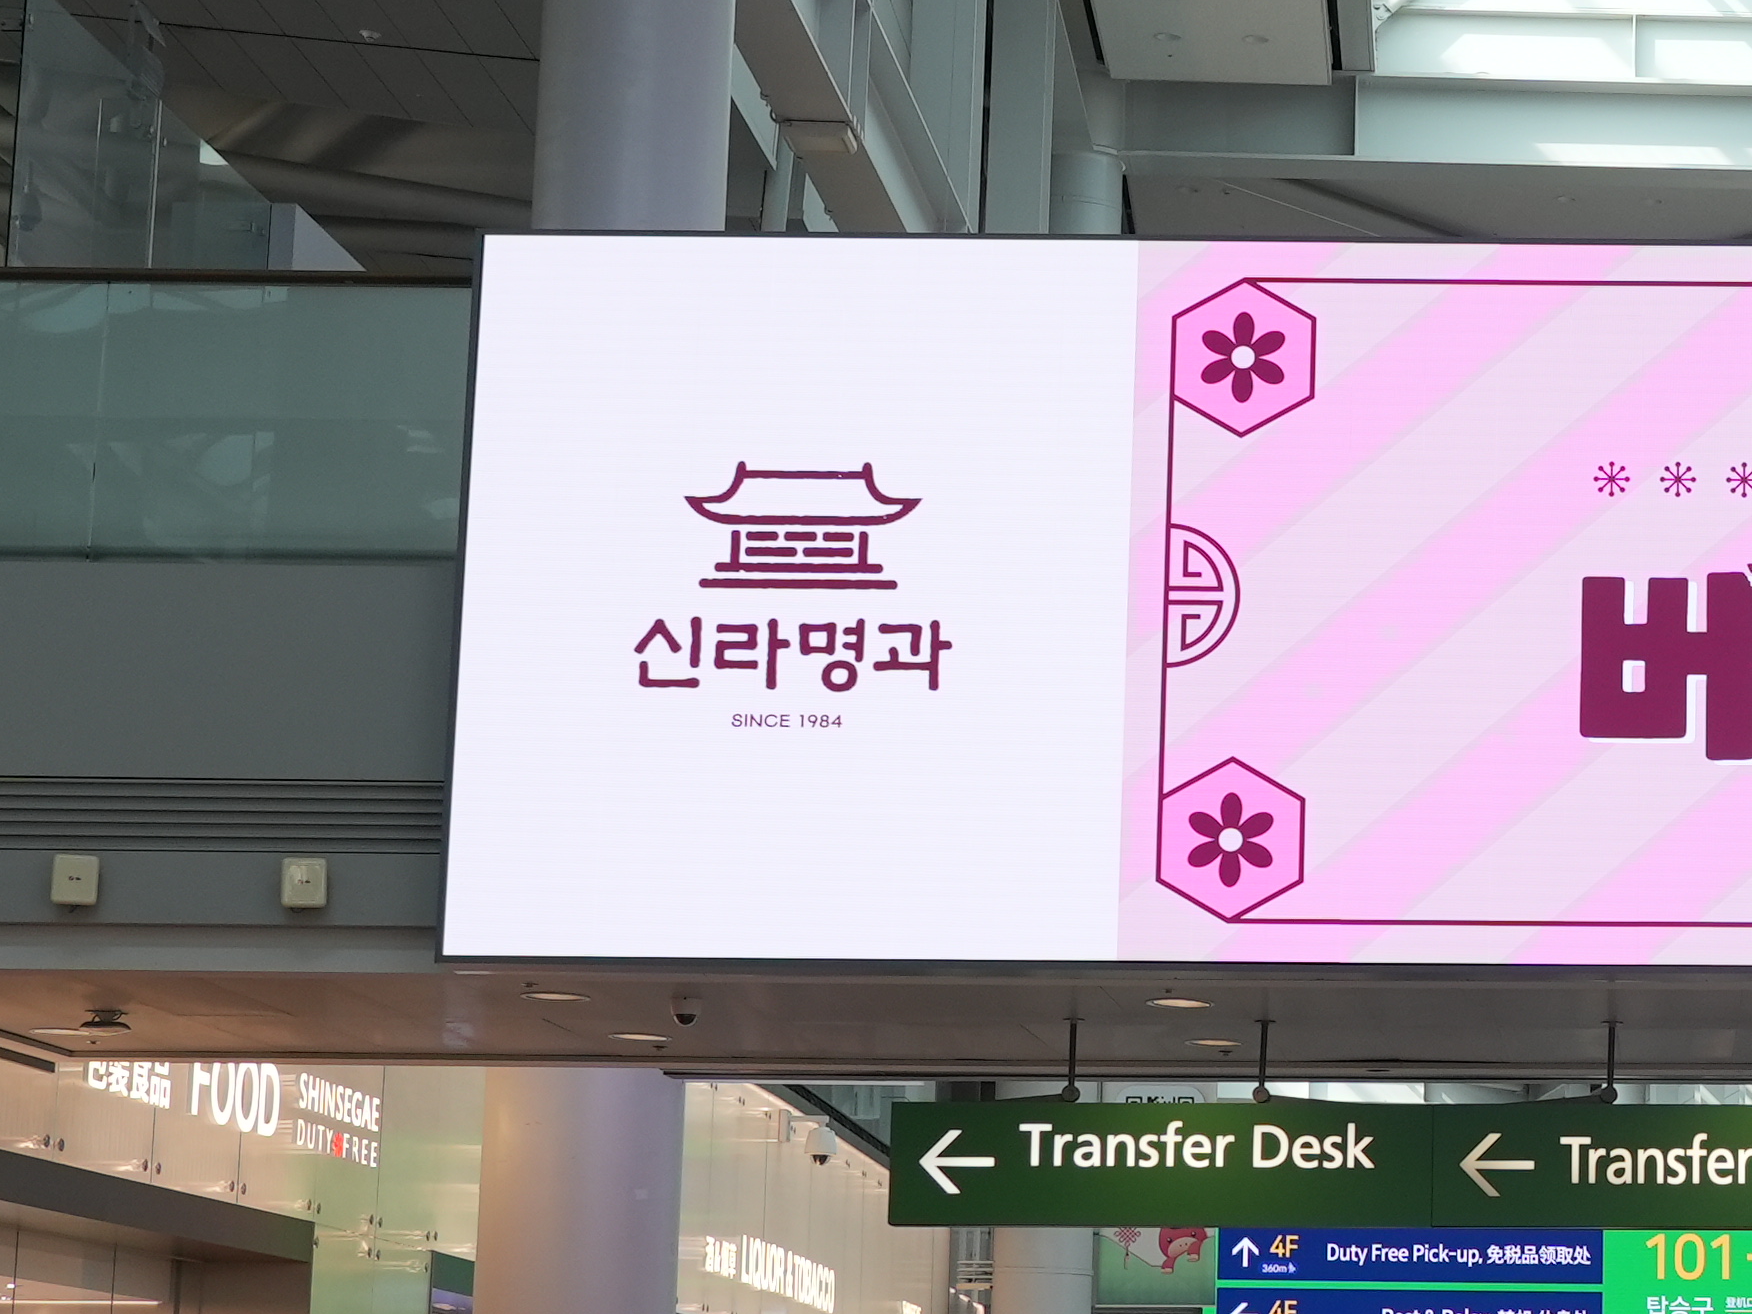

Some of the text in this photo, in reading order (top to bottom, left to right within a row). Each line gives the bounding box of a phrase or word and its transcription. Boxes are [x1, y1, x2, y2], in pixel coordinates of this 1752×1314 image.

[630, 609, 953, 696] 신라명과
[731, 713, 842, 728] SINCE 1984
[188, 1062, 281, 1137] FOOD
[298, 1072, 381, 1133] SHINSEGAE
[296, 1118, 378, 1169] DUTY FREE
[1019, 1120, 1376, 1170] Transfer Desk
[1262, 1262, 1288, 1274] 360m
[1269, 1234, 1299, 1259] 4F
[1326, 1242, 1592, 1267] Duty Free Pick-up, 免税品领取处
[1645, 1232, 1732, 1280] 101
[740, 1233, 785, 1296] LIQUOR
[785, 1250, 794, 1298] &
[794, 1253, 836, 1314] TOBACCO
